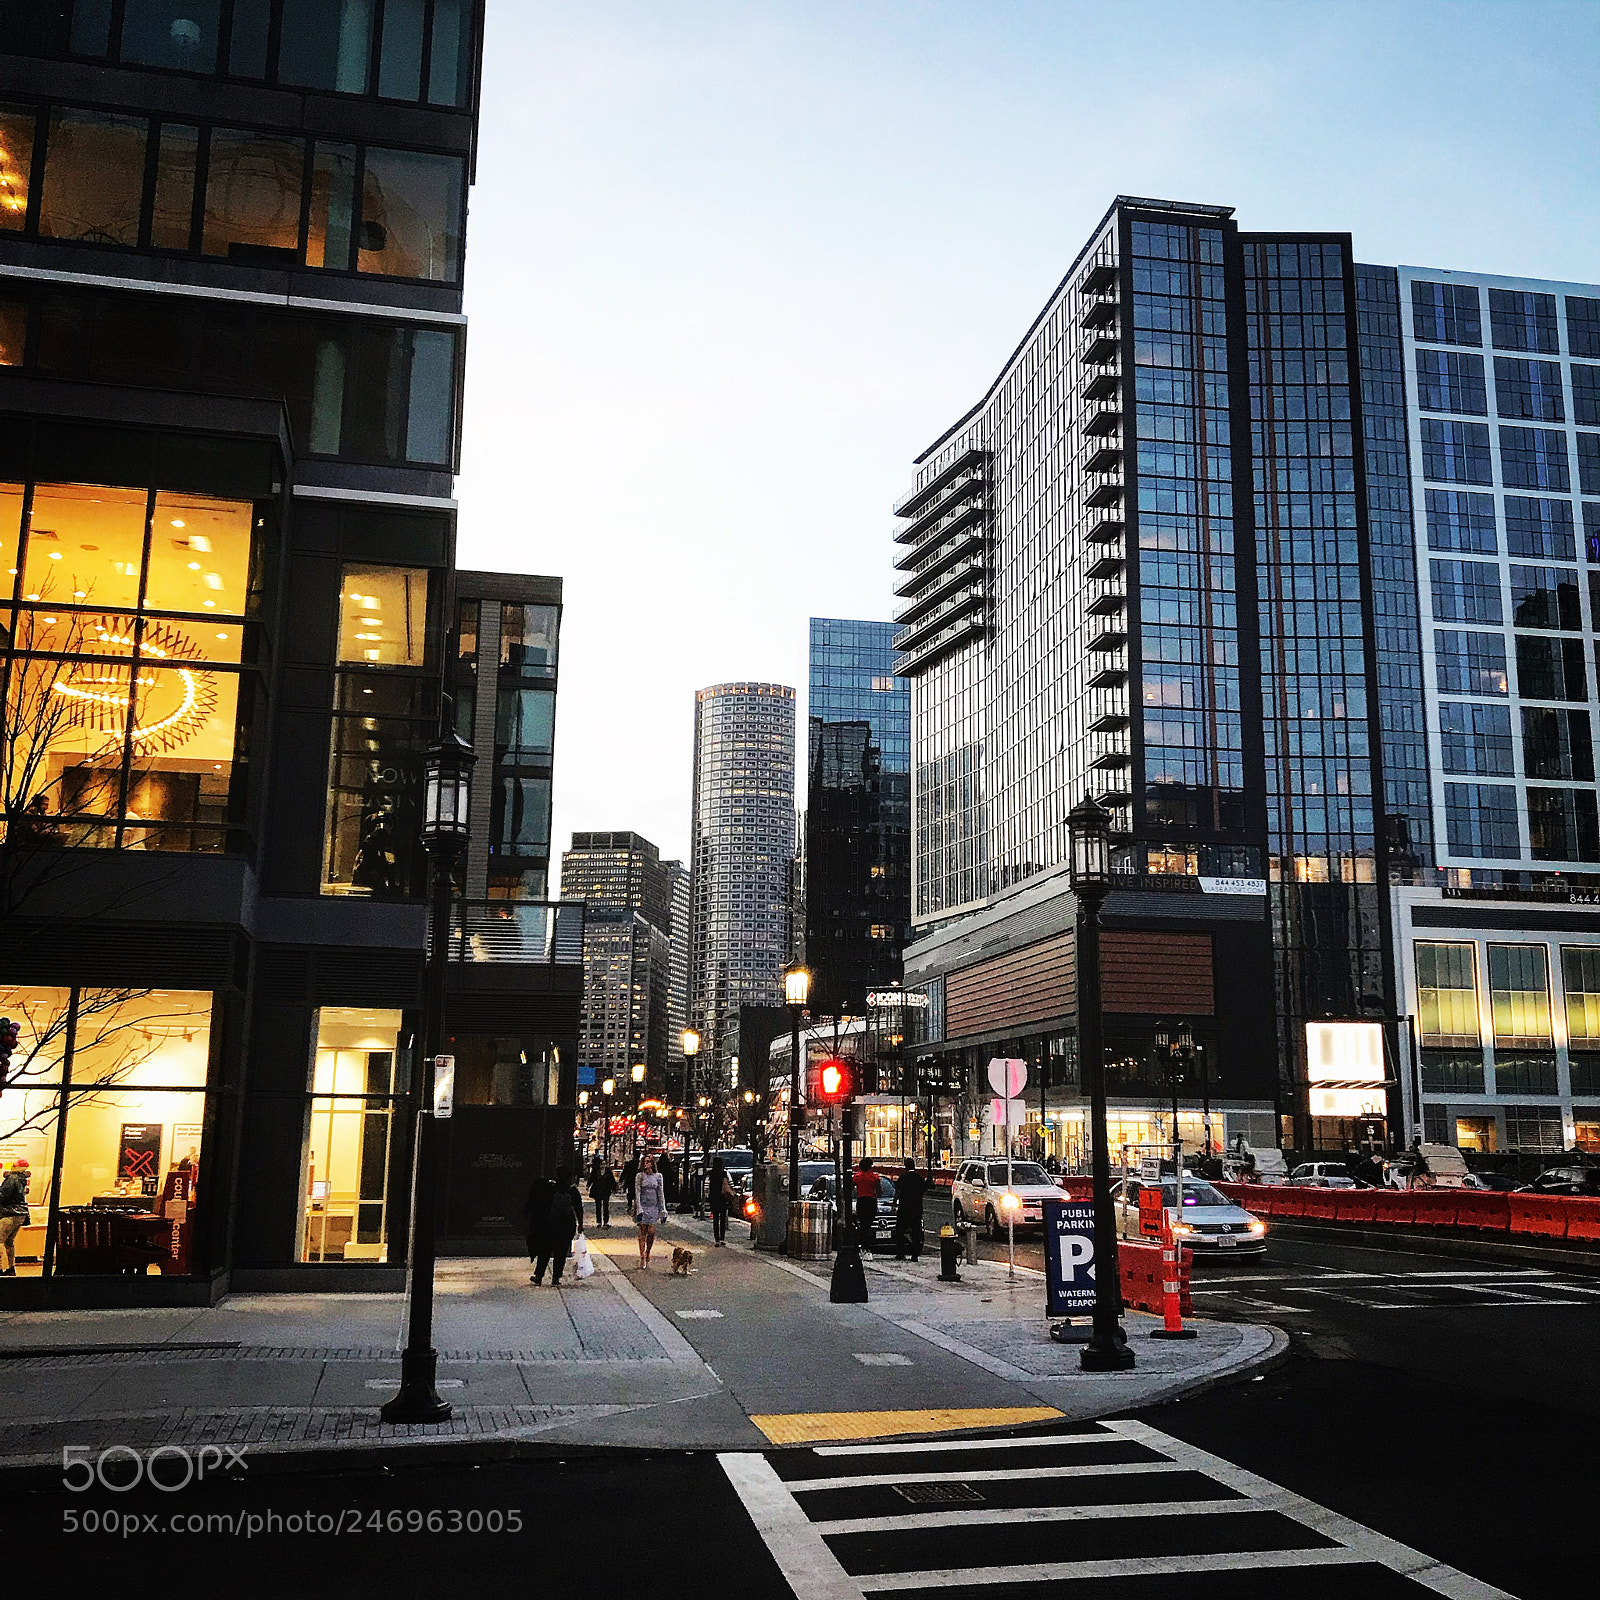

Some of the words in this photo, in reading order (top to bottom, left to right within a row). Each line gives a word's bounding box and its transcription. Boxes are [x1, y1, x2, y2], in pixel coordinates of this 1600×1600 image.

[1140, 877, 1197, 890] INSPIRED
[1056, 1220, 1095, 1229] PARKIN
[170, 1222, 182, 1260] center
[1058, 1289, 1097, 1298] WATERM
